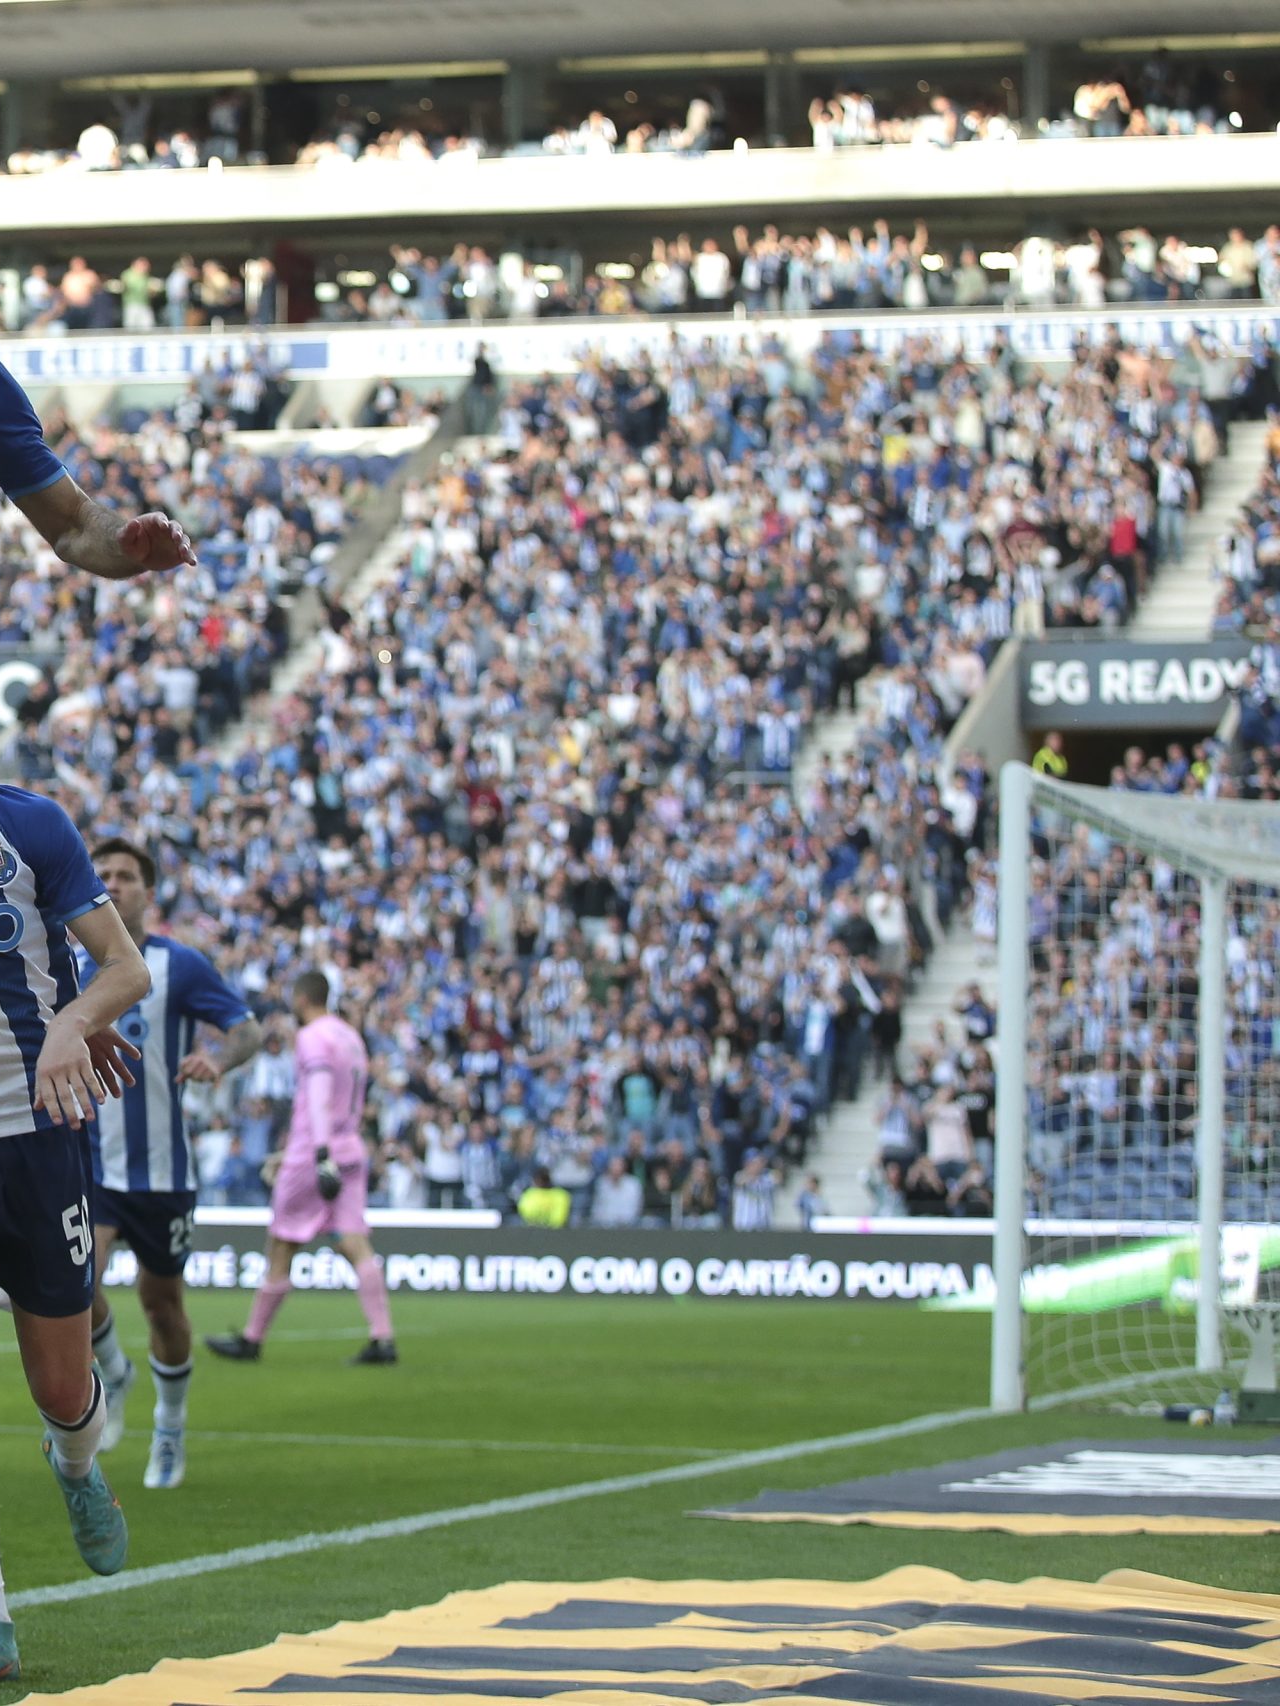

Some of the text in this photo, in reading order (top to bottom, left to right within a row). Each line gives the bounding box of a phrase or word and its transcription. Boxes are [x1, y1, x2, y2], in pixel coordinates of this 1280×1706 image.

[1028, 659, 1091, 705] 5G
[386, 1253, 461, 1291] POR
[464, 1254, 567, 1293] LITRO
[569, 1256, 658, 1294] COM
[661, 1257, 694, 1295] O
[696, 1252, 841, 1297] CARTÃO
[844, 1260, 968, 1299] POUPA
